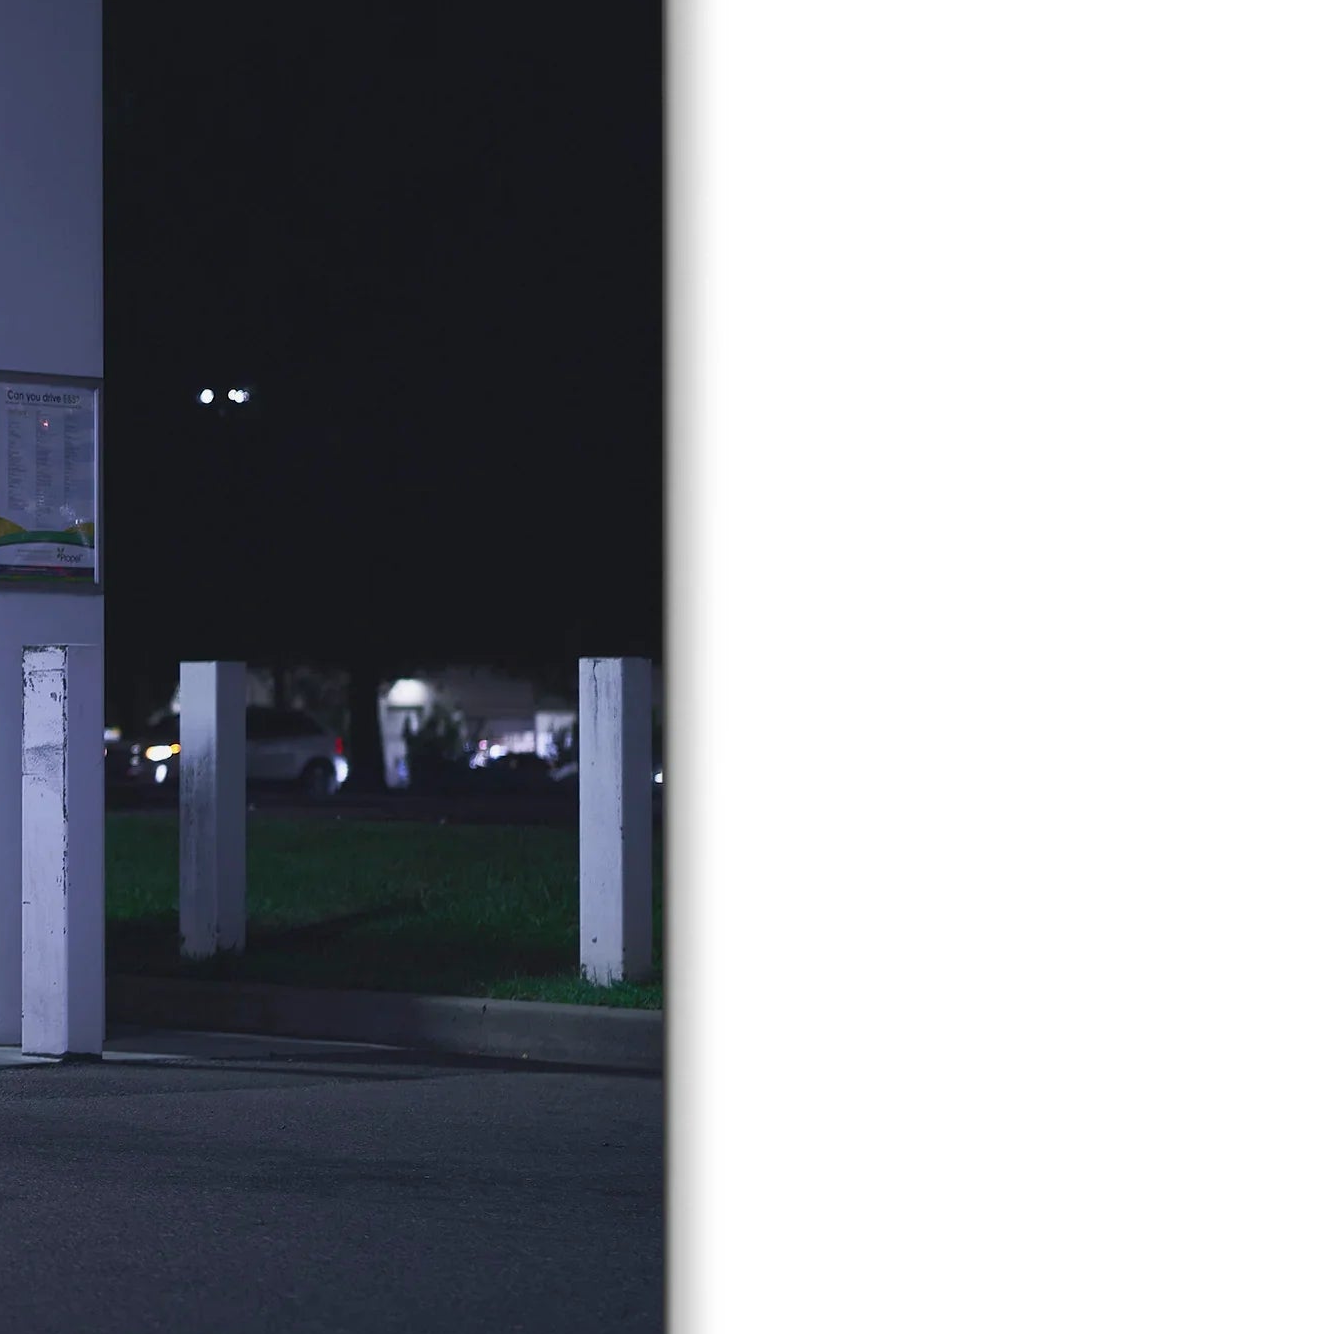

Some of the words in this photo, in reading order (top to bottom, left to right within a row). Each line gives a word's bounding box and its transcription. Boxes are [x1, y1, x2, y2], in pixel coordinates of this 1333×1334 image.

[7, 389, 24, 401] Can
[26, 392, 41, 403] you
[42, 392, 61, 403] drive
